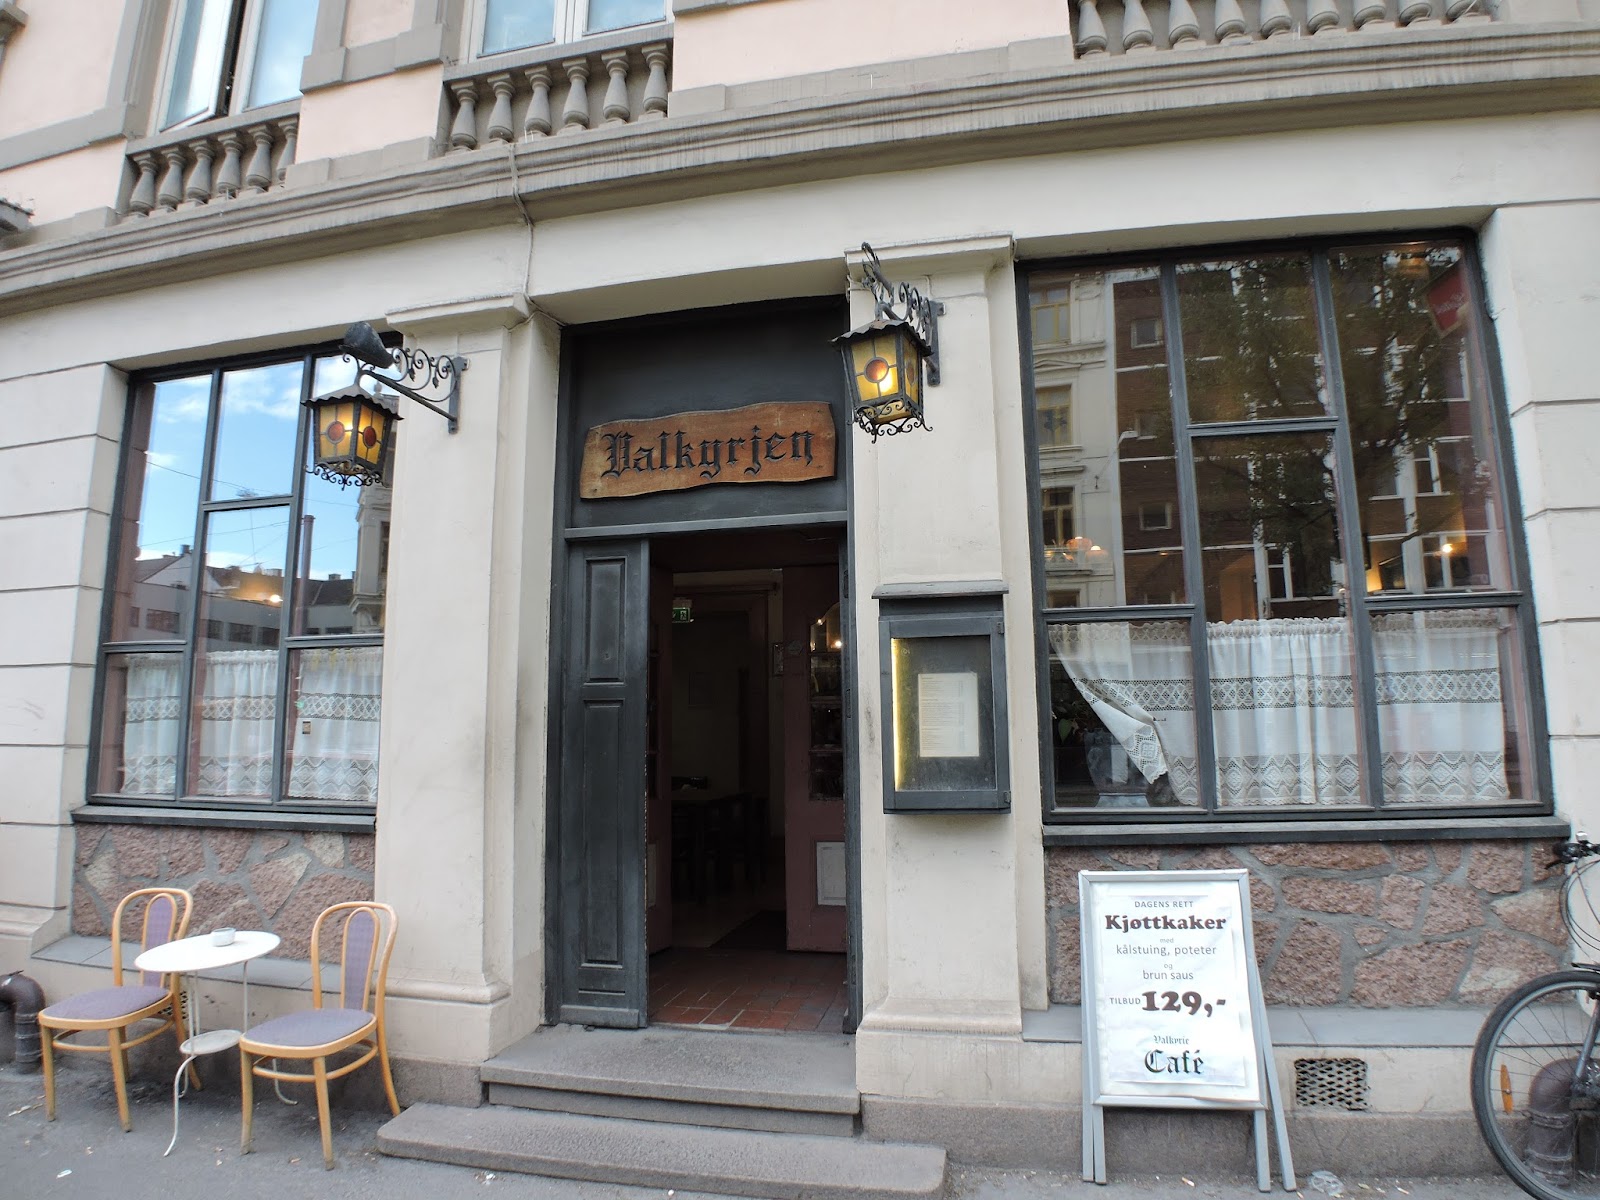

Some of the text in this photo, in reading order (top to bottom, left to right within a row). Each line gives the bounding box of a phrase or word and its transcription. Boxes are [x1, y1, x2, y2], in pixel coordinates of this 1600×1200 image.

[601, 425, 815, 479] Valkyrjen
[1105, 915, 1227, 933] Kjøttkaker
[1116, 944, 1217, 956] kålstuing, poteter
[1142, 970, 1194, 980] brun saus
[1109, 991, 1226, 1018] TILBUD 129,-
[1153, 1034, 1190, 1045] Valkyrie
[1144, 1049, 1204, 1074] Café
